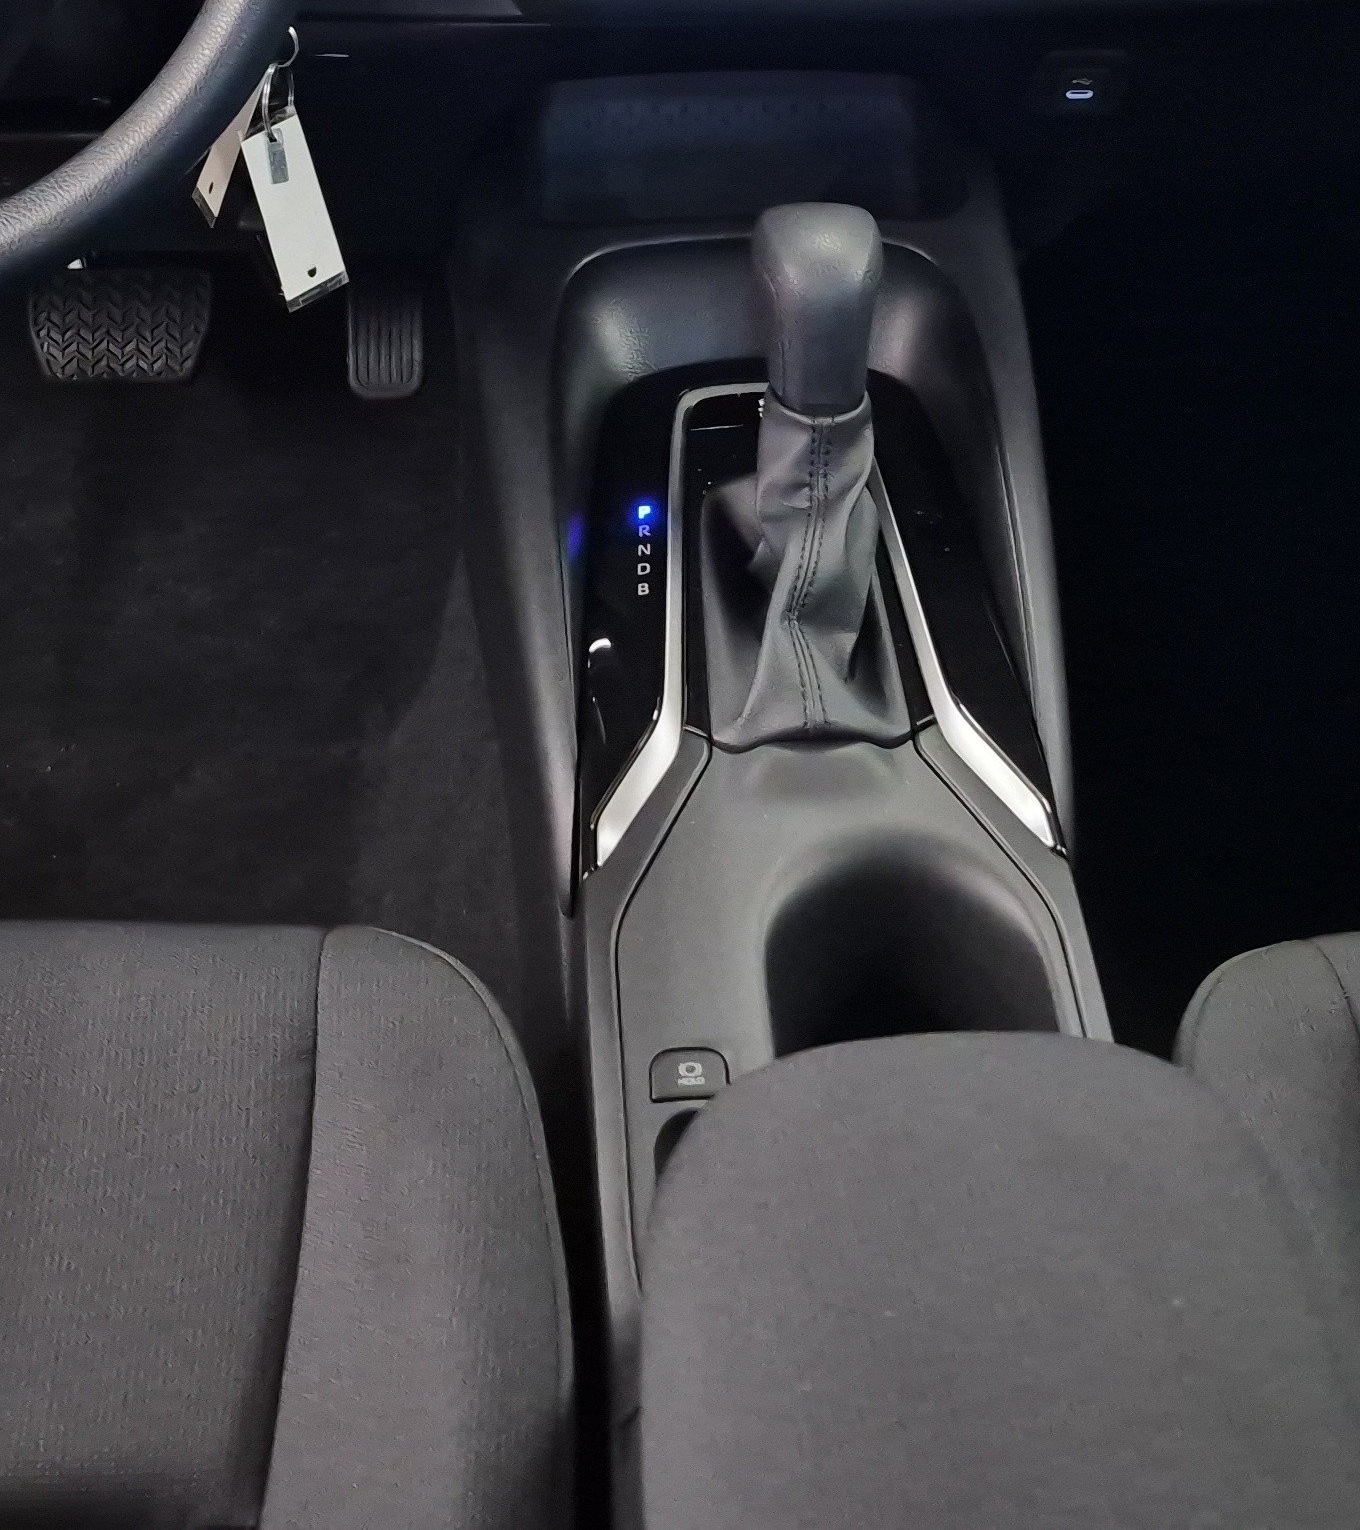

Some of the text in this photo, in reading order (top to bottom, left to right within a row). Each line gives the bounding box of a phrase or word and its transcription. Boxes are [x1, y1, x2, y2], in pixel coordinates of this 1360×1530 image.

[638, 505, 651, 519] P
[638, 524, 651, 537] R
[637, 543, 651, 556] N
[637, 562, 651, 576] D
[637, 582, 650, 596] B
